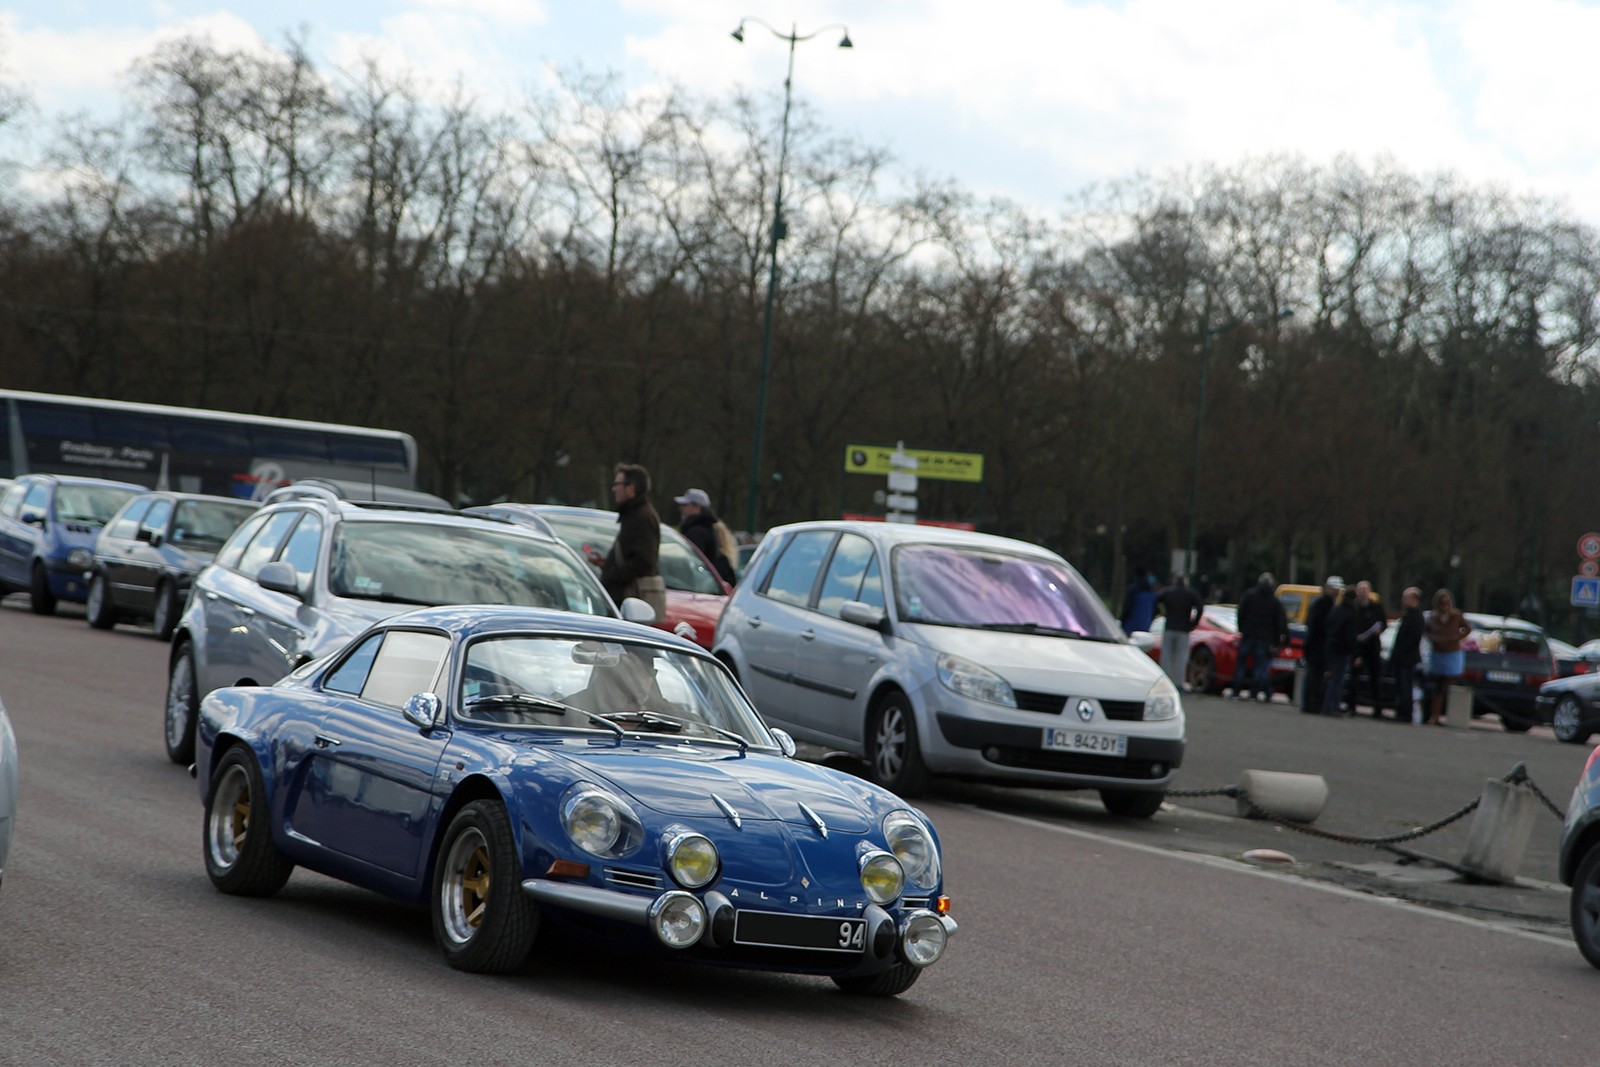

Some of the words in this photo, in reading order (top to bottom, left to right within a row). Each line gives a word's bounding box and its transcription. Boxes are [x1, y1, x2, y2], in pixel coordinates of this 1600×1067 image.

[1054, 731, 1070, 747] CL
[1074, 734, 1097, 750] 842
[731, 888, 864, 909] ALPINE
[838, 922, 865, 948] 94
